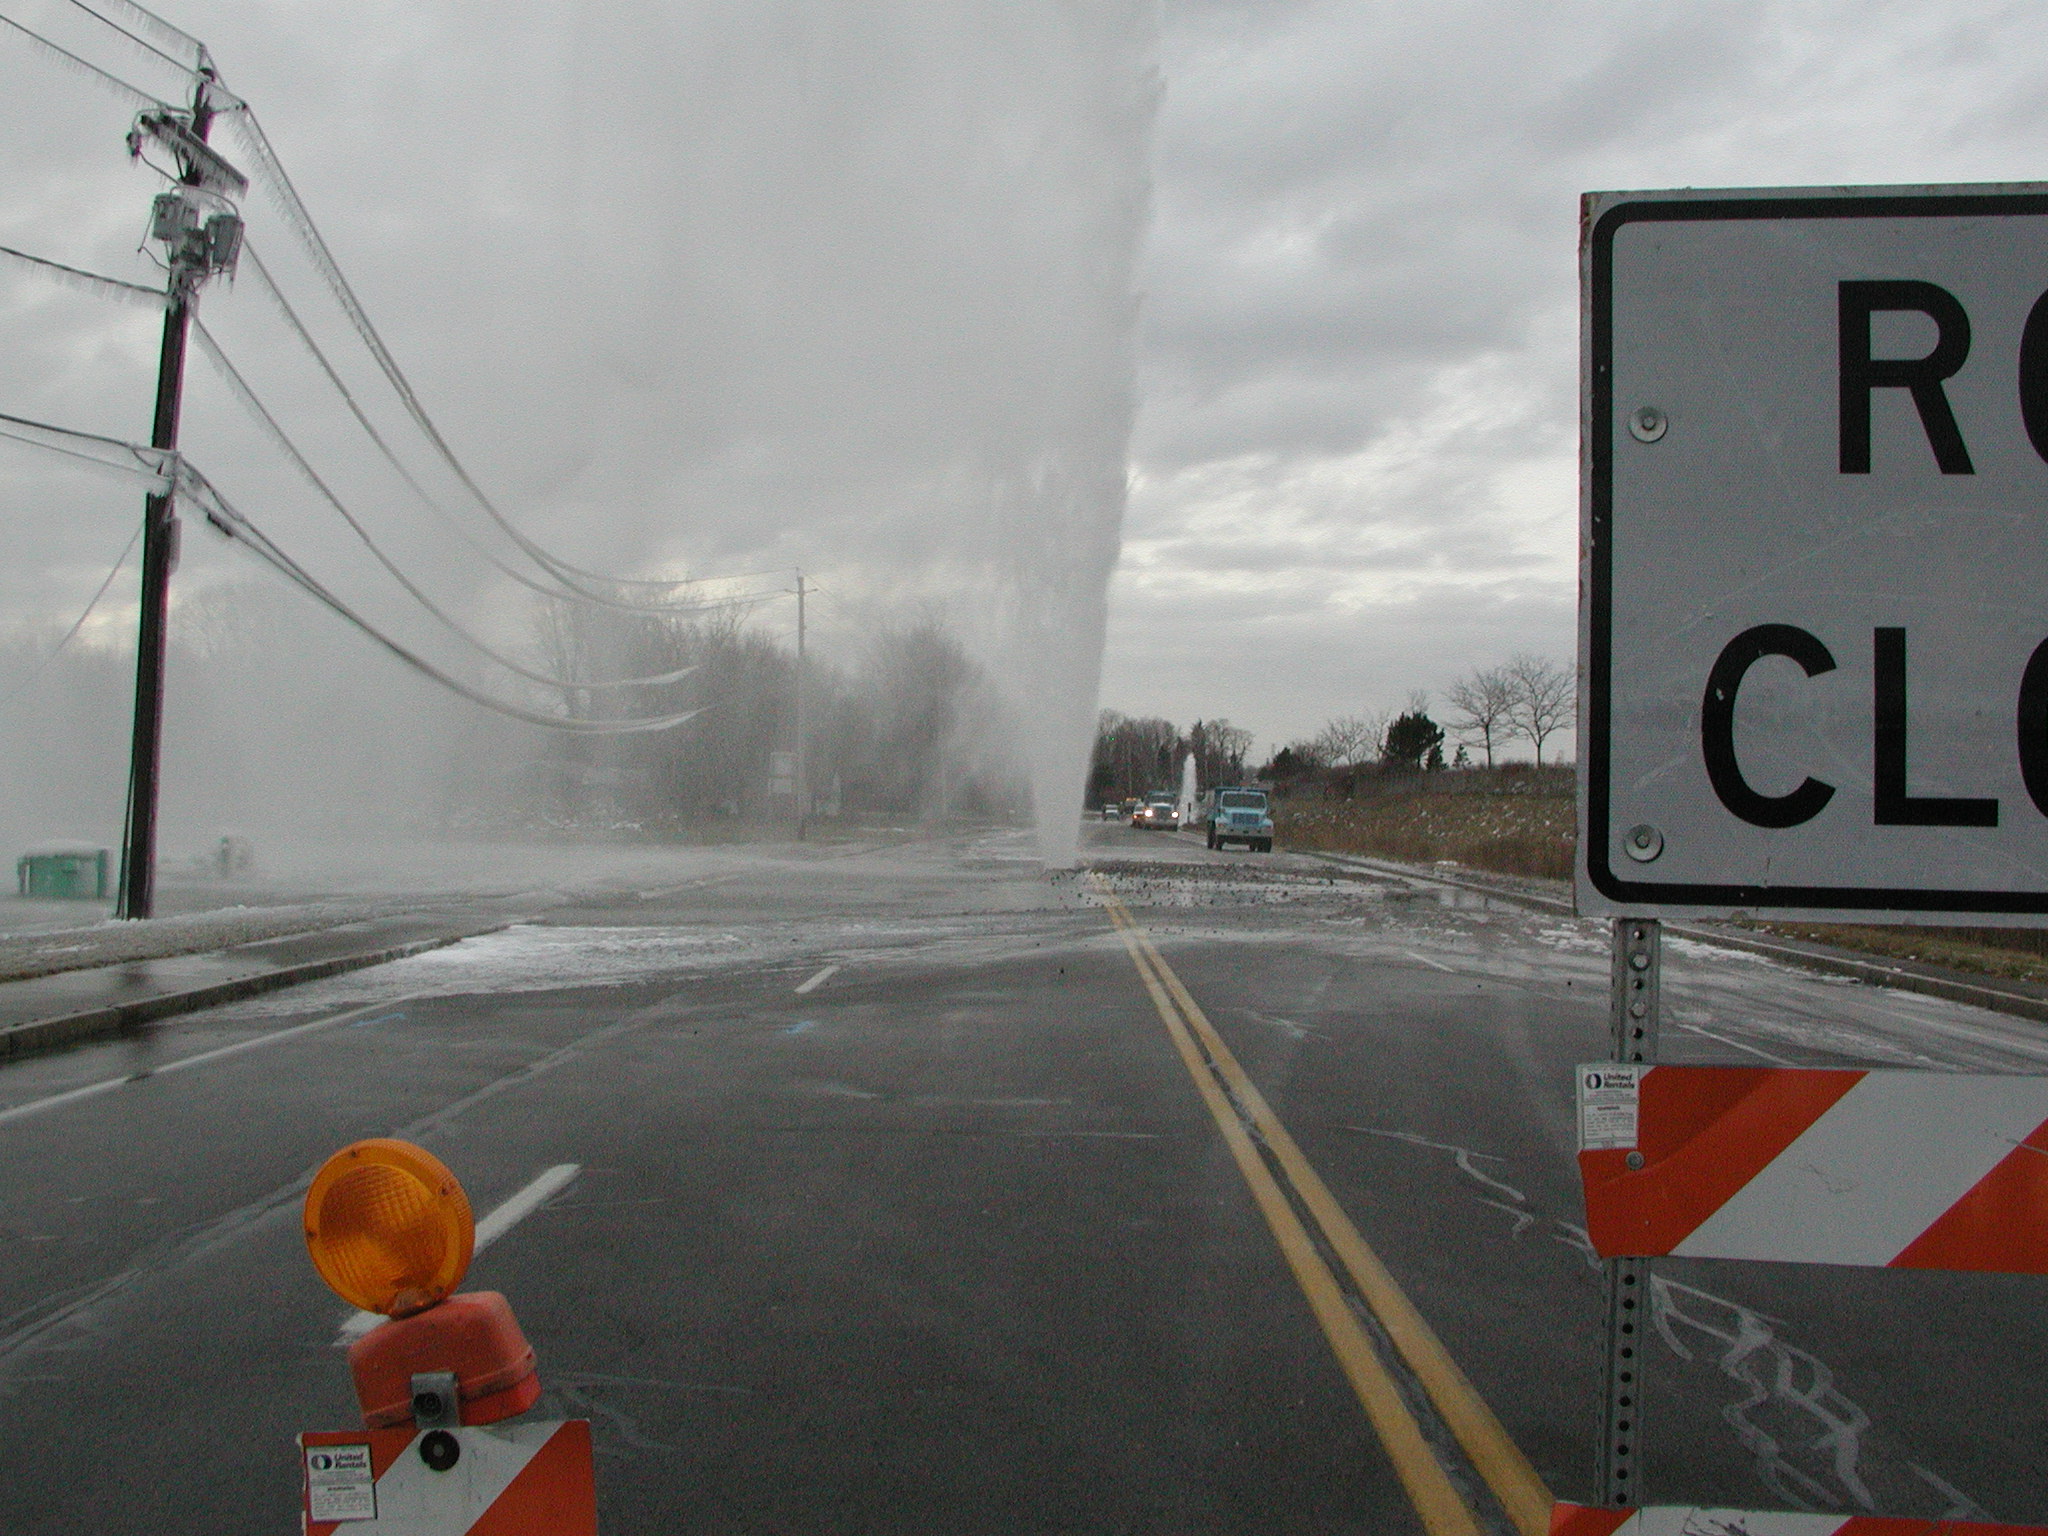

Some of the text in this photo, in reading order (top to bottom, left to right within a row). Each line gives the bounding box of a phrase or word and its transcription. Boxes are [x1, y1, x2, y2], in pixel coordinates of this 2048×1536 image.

[1837, 278, 2048, 476] R
[1700, 622, 2048, 830] CL
[1604, 1073, 1632, 1081] United
[1604, 1080, 1635, 1089] Rentals
[334, 1452, 363, 1461] United
[335, 1461, 366, 1469] Rentals
